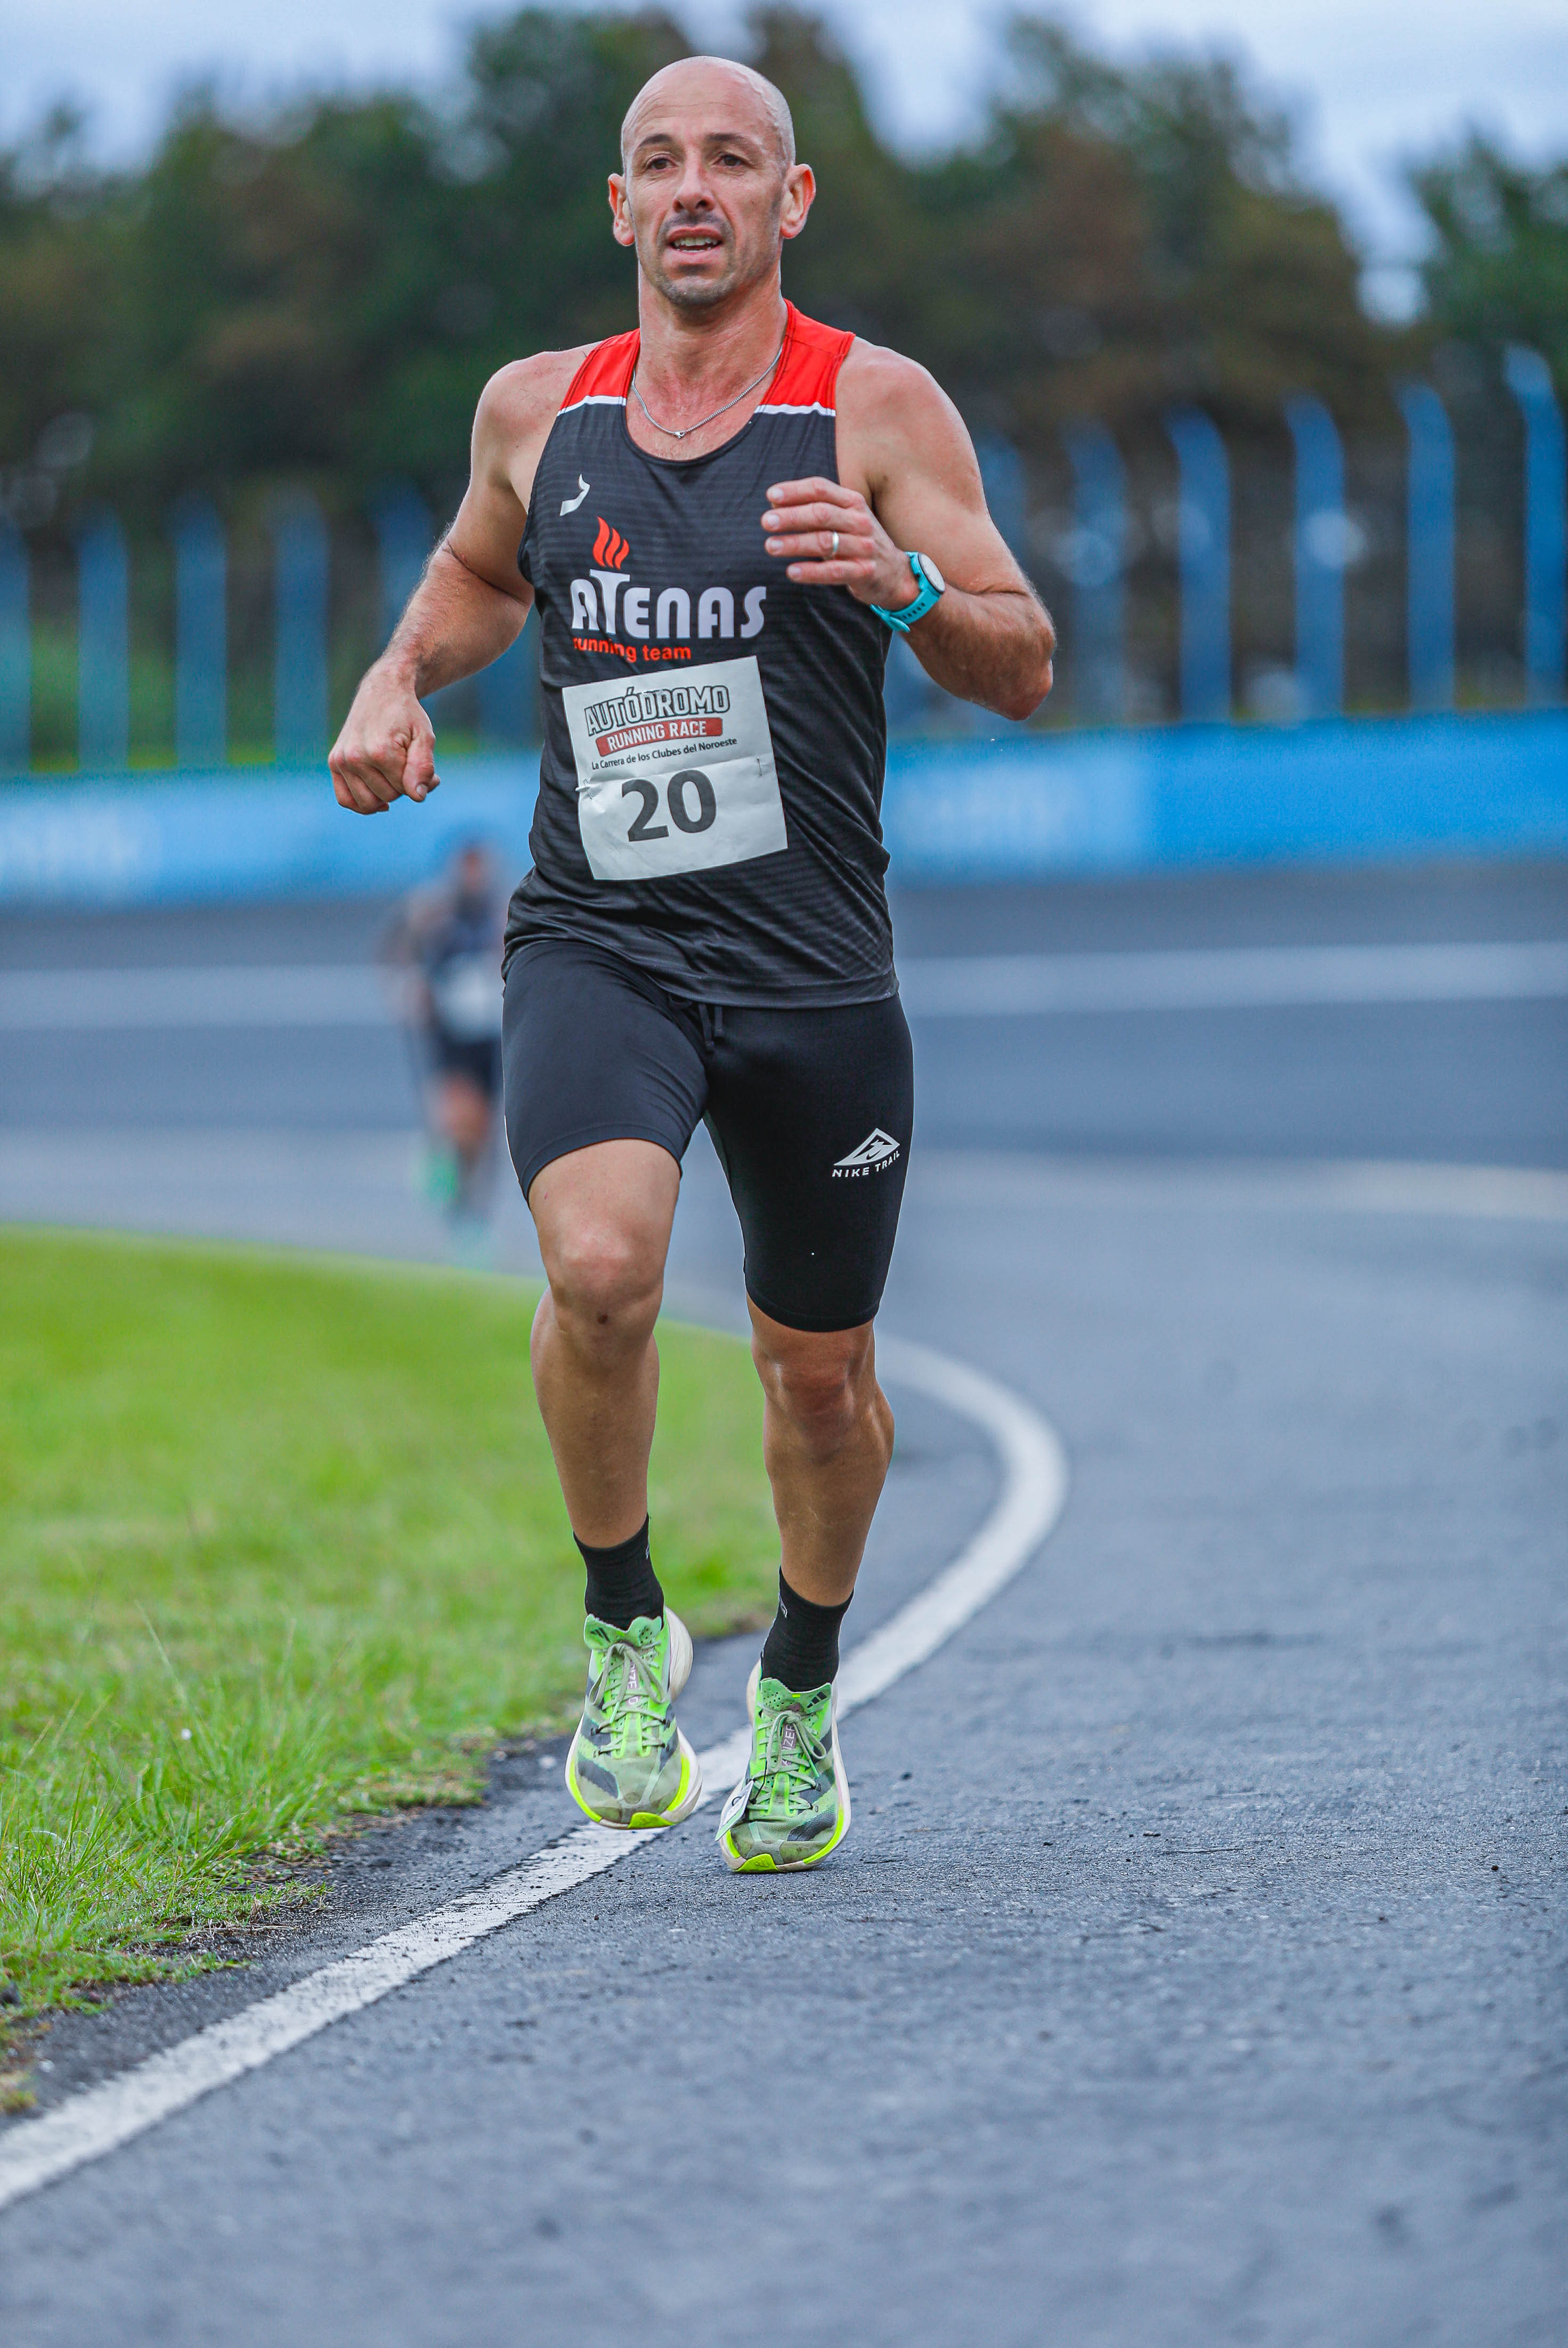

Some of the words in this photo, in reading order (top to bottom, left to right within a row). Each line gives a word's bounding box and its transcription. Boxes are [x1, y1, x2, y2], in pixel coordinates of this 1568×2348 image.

[570, 568, 767, 639] ATENAS
[573, 637, 637, 663] running
[642, 644, 691, 661] team
[584, 685, 730, 737] AUTÓDROMO
[606, 723, 665, 751] RUNNING
[669, 720, 708, 737] RACE
[591, 761, 599, 770] La
[599, 757, 625, 768] Carrera
[626, 754, 637, 764] de
[638, 752, 651, 762] los
[652, 748, 682, 759] Clubes
[683, 744, 697, 754] del
[698, 738, 737, 751] Noroeste
[621, 769, 718, 842] 20
[832, 1166, 870, 1178] NIKE
[874, 1150, 900, 1173] TRAIL
